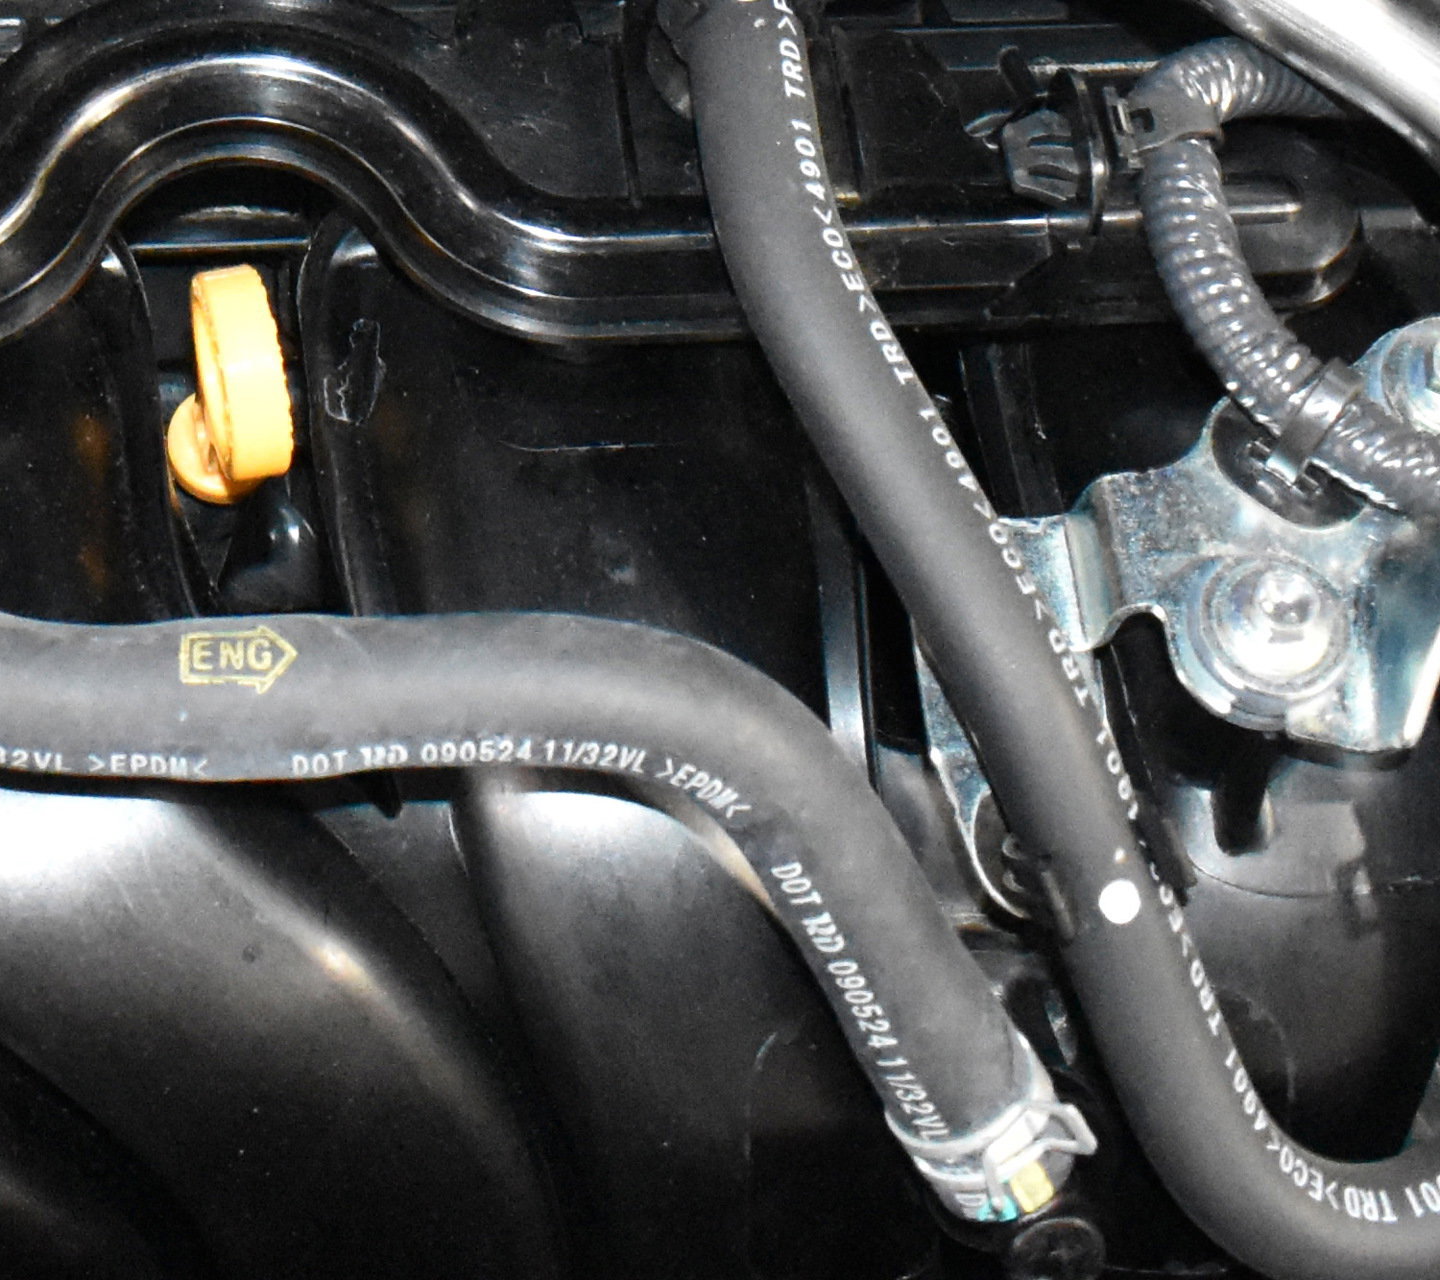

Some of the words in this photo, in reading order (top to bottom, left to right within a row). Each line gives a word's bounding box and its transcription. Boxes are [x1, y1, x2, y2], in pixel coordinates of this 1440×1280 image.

[191, 635, 276, 674] ENG
[290, 749, 348, 777] DOT
[420, 738, 533, 763] 090524
[770, 861, 822, 907] DOT
[826, 958, 899, 1050] 090524
